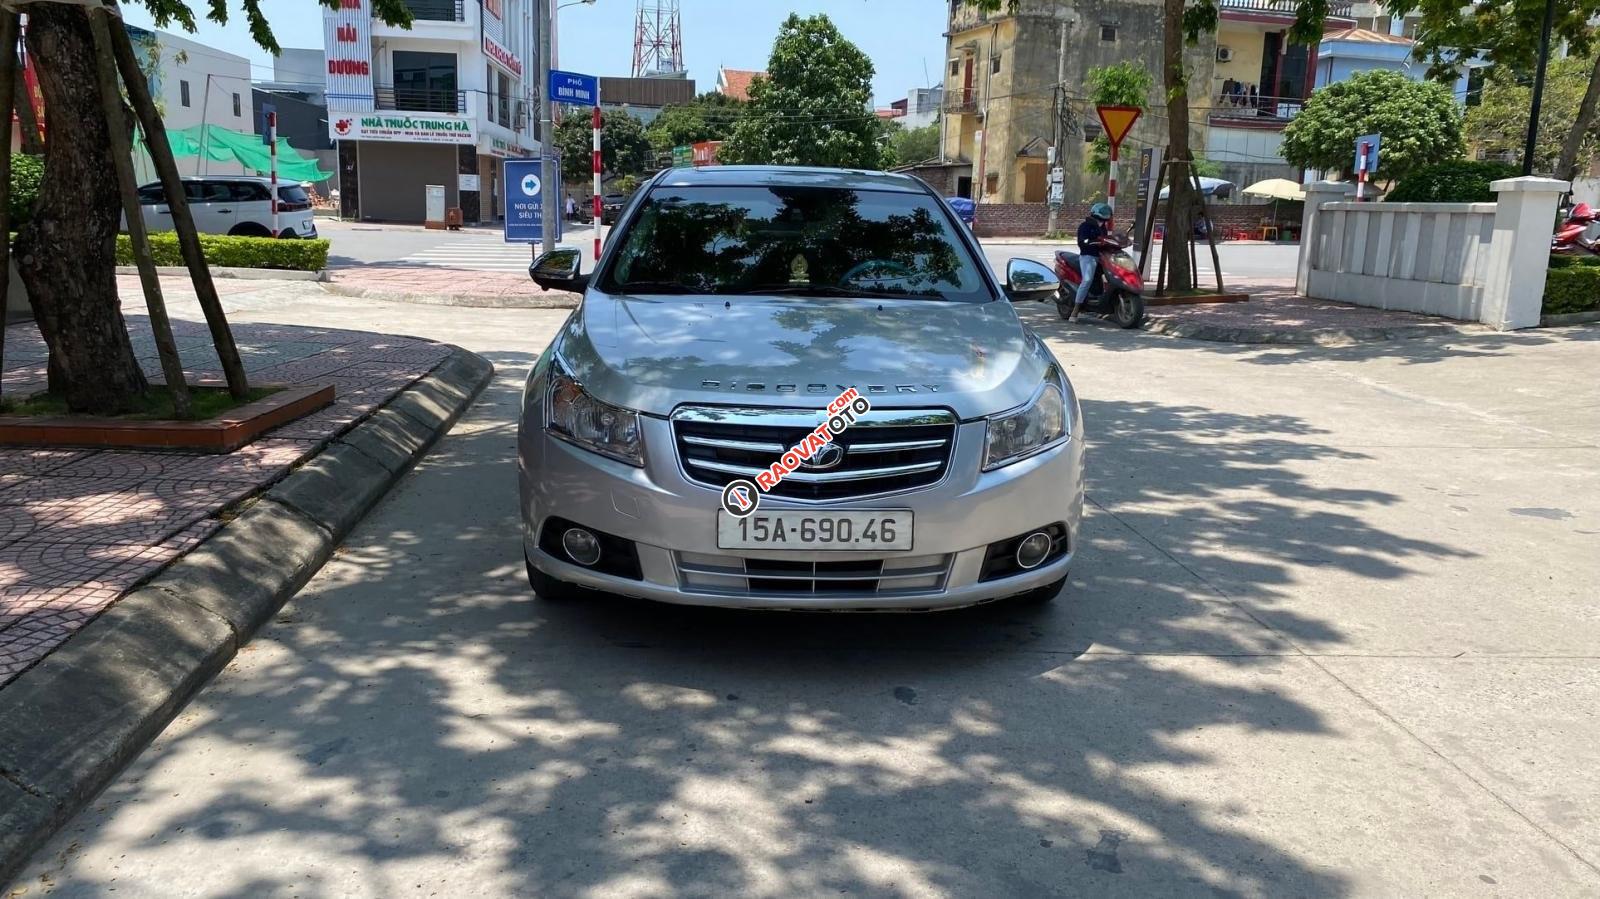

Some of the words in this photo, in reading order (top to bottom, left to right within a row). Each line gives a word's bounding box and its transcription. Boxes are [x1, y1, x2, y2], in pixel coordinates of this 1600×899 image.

[567, 77, 583, 86] PHỐ
[558, 86, 574, 97] BÌNH
[575, 89, 590, 100] MINH
[361, 116, 383, 128] NHÀ
[384, 116, 418, 129] THUỐC
[419, 120, 453, 130] TRUNG
[454, 120, 470, 131] HÀ
[738, 517, 897, 543] 15A-690.46
